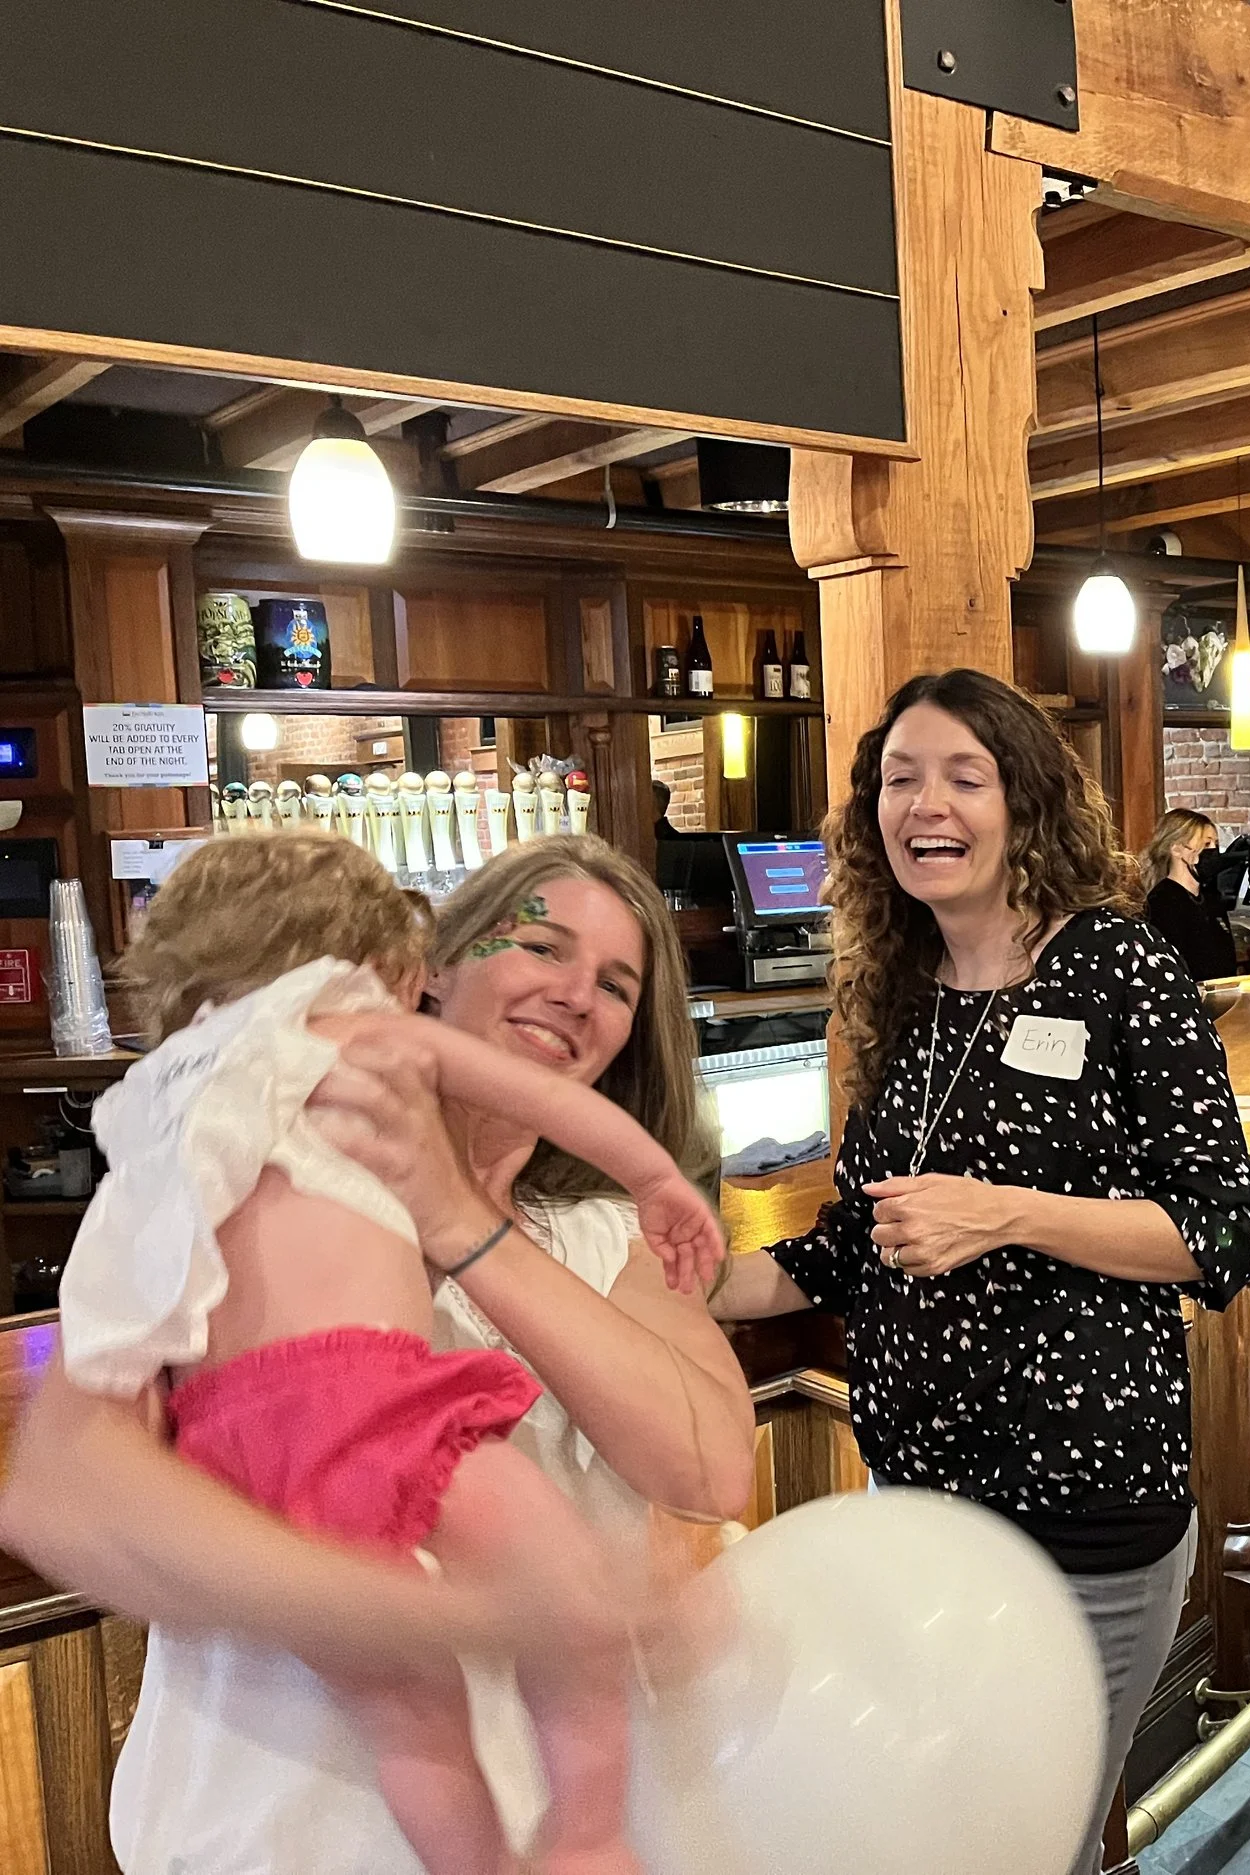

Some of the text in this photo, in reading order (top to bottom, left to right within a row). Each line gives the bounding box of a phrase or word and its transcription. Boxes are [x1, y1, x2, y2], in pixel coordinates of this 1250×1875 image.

[112, 723, 176, 732] 20% GRATUITY
[89, 735, 199, 743] WILL BE ADDED TO EVERY
[109, 746, 183, 754] TAB OPEN AT THE
[106, 757, 124, 765] END
[126, 757, 137, 765] OF
[141, 757, 157, 765] THE
[1022, 1029, 1067, 1057] Erin
